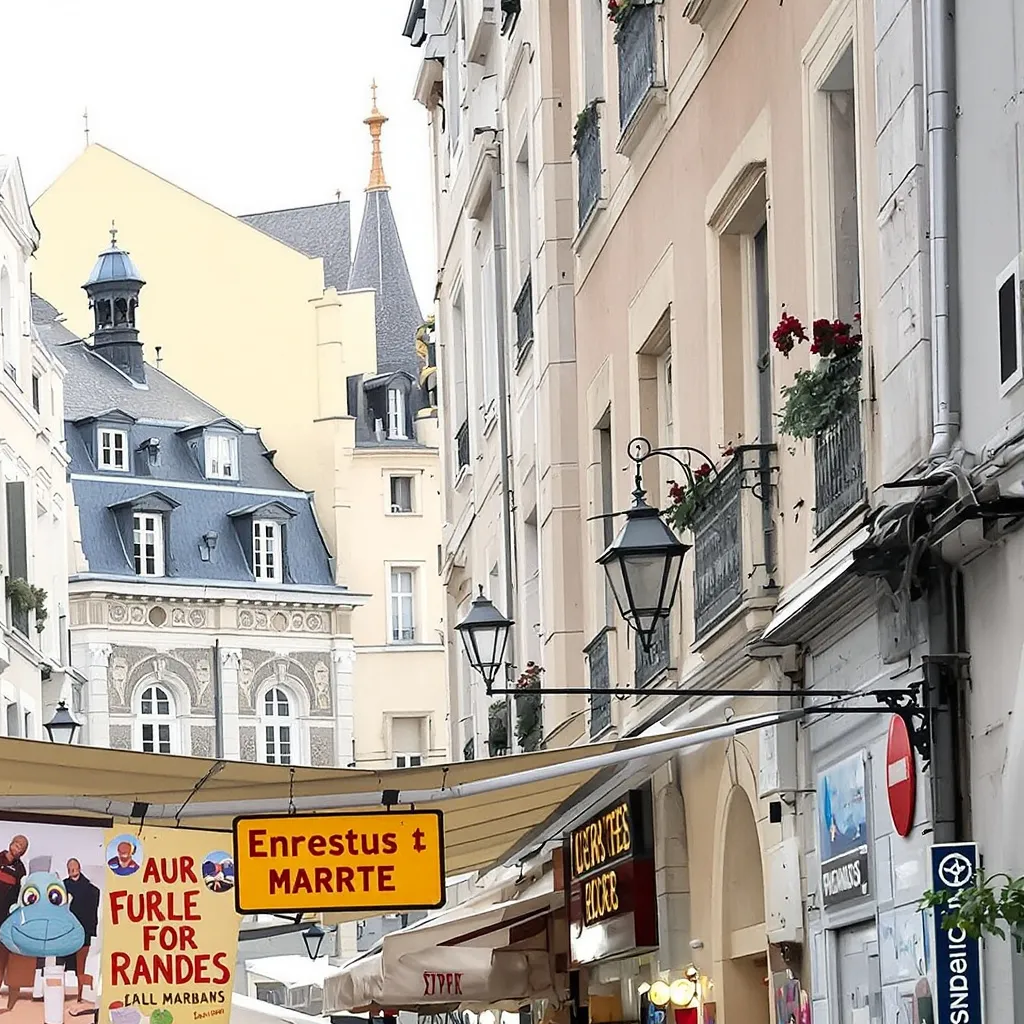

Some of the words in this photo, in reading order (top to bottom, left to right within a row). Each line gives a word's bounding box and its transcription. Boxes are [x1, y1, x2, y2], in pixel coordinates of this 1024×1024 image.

[248, 829, 398, 858] Enrestus
[142, 856, 198, 884] AUR
[269, 865, 396, 895] MARRTE
[109, 889, 202, 925] FURLE
[142, 925, 198, 951] FOR
[111, 952, 231, 986] RANDES
[162, 990, 226, 1005] MARBANS
